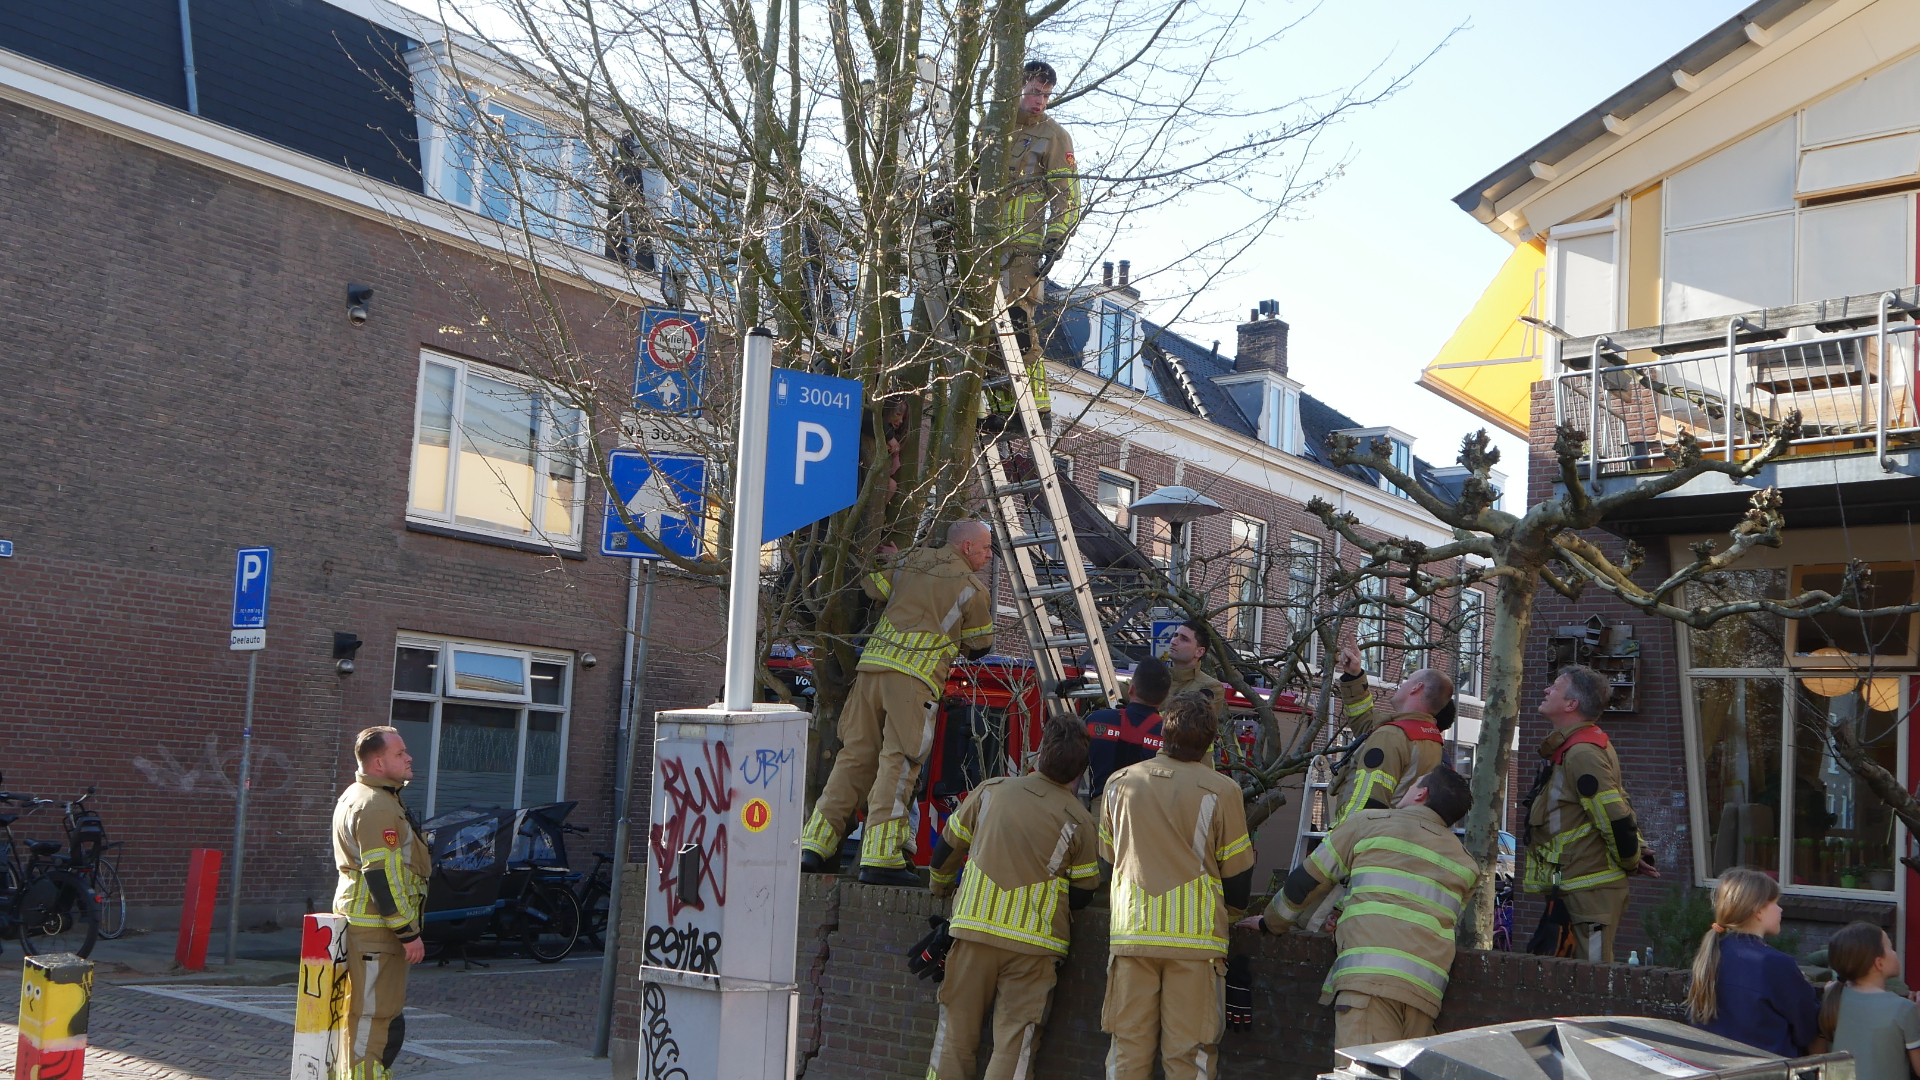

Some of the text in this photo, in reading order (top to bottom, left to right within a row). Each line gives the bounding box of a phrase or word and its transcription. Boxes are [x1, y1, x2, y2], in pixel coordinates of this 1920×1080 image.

[799, 386, 850, 410] 30041
[795, 420, 832, 485] P
[242, 555, 261, 594] P
[232, 635, 261, 645] Deelauto
